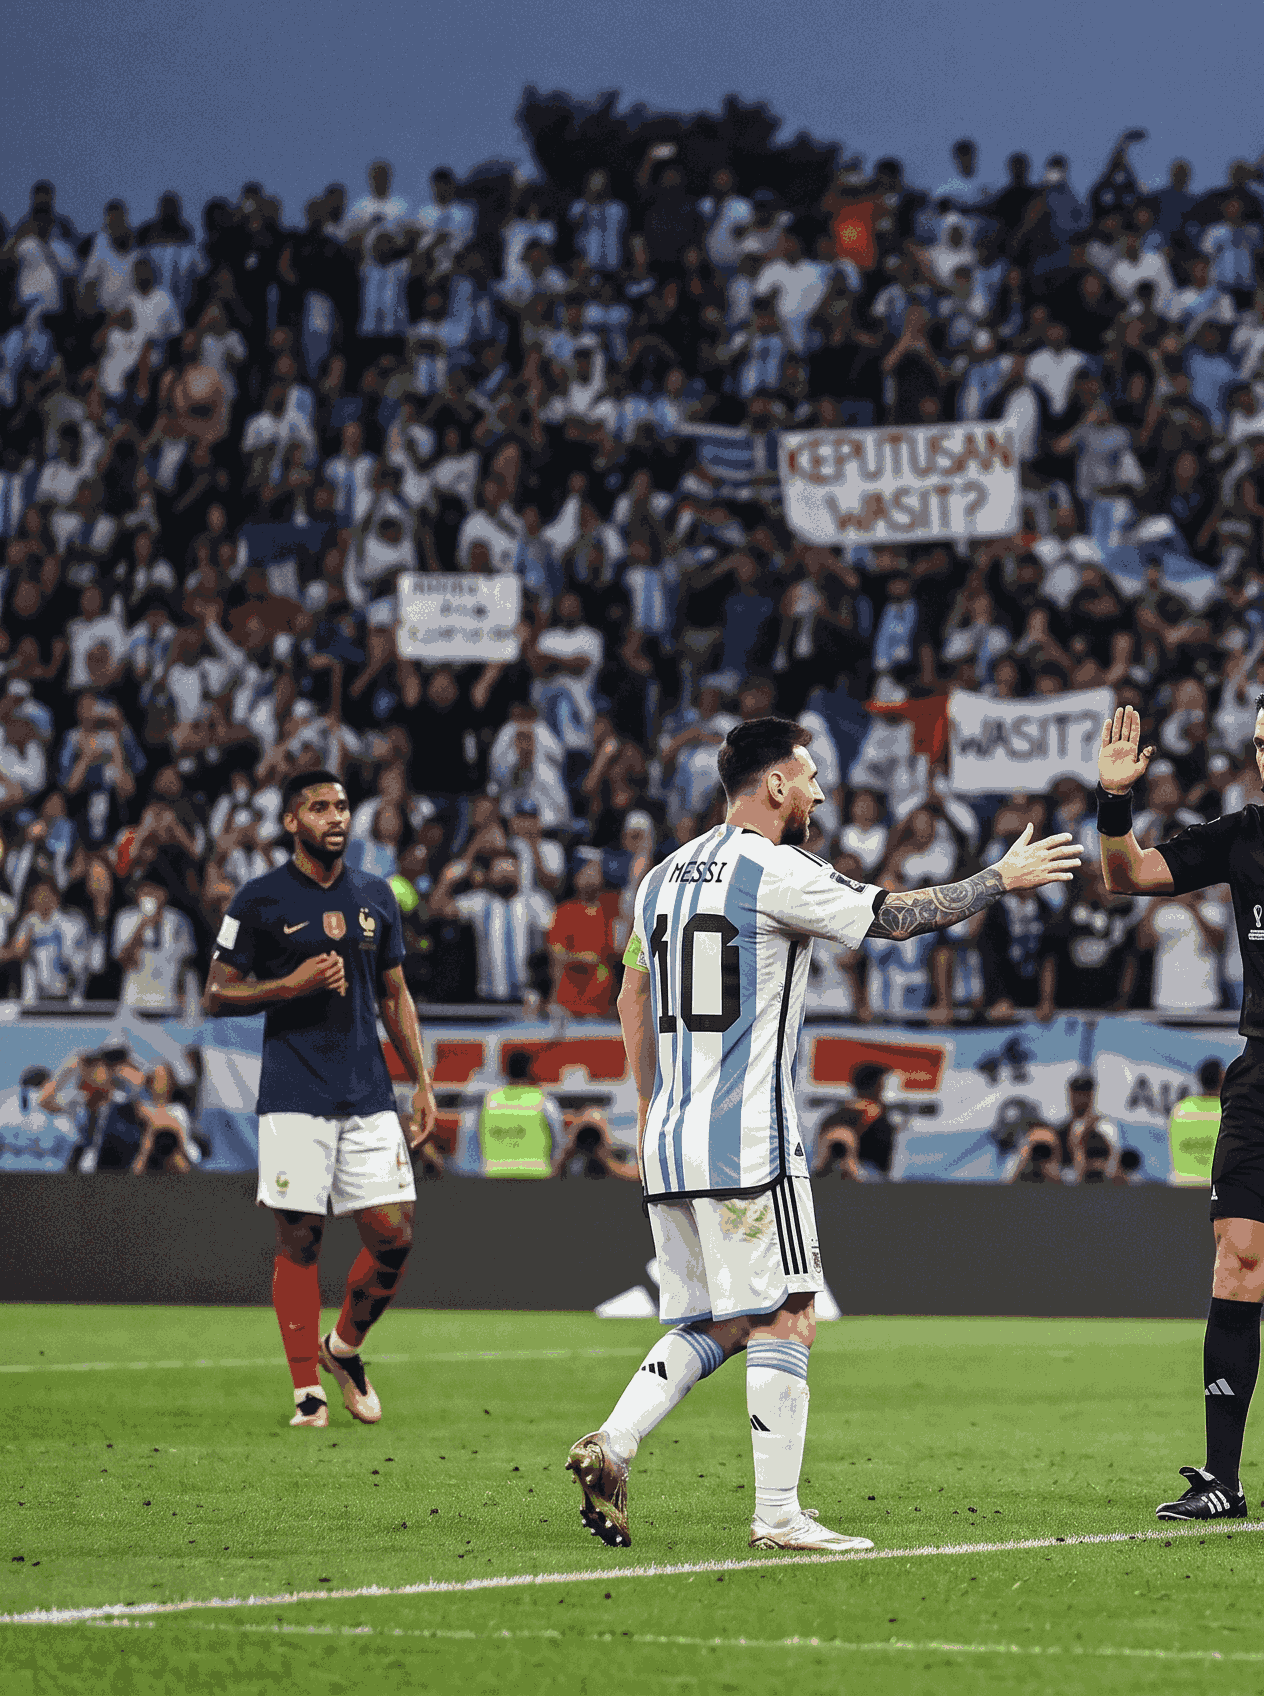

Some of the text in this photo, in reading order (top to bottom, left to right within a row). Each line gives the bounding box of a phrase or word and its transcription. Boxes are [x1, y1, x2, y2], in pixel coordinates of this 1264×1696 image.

[787, 430, 1014, 485] KEPUTUSAN
[825, 479, 988, 534] WASIT?
[949, 710, 1102, 763] WASIT?
[669, 861, 728, 884] MESSI
[650, 913, 742, 1033] 10
